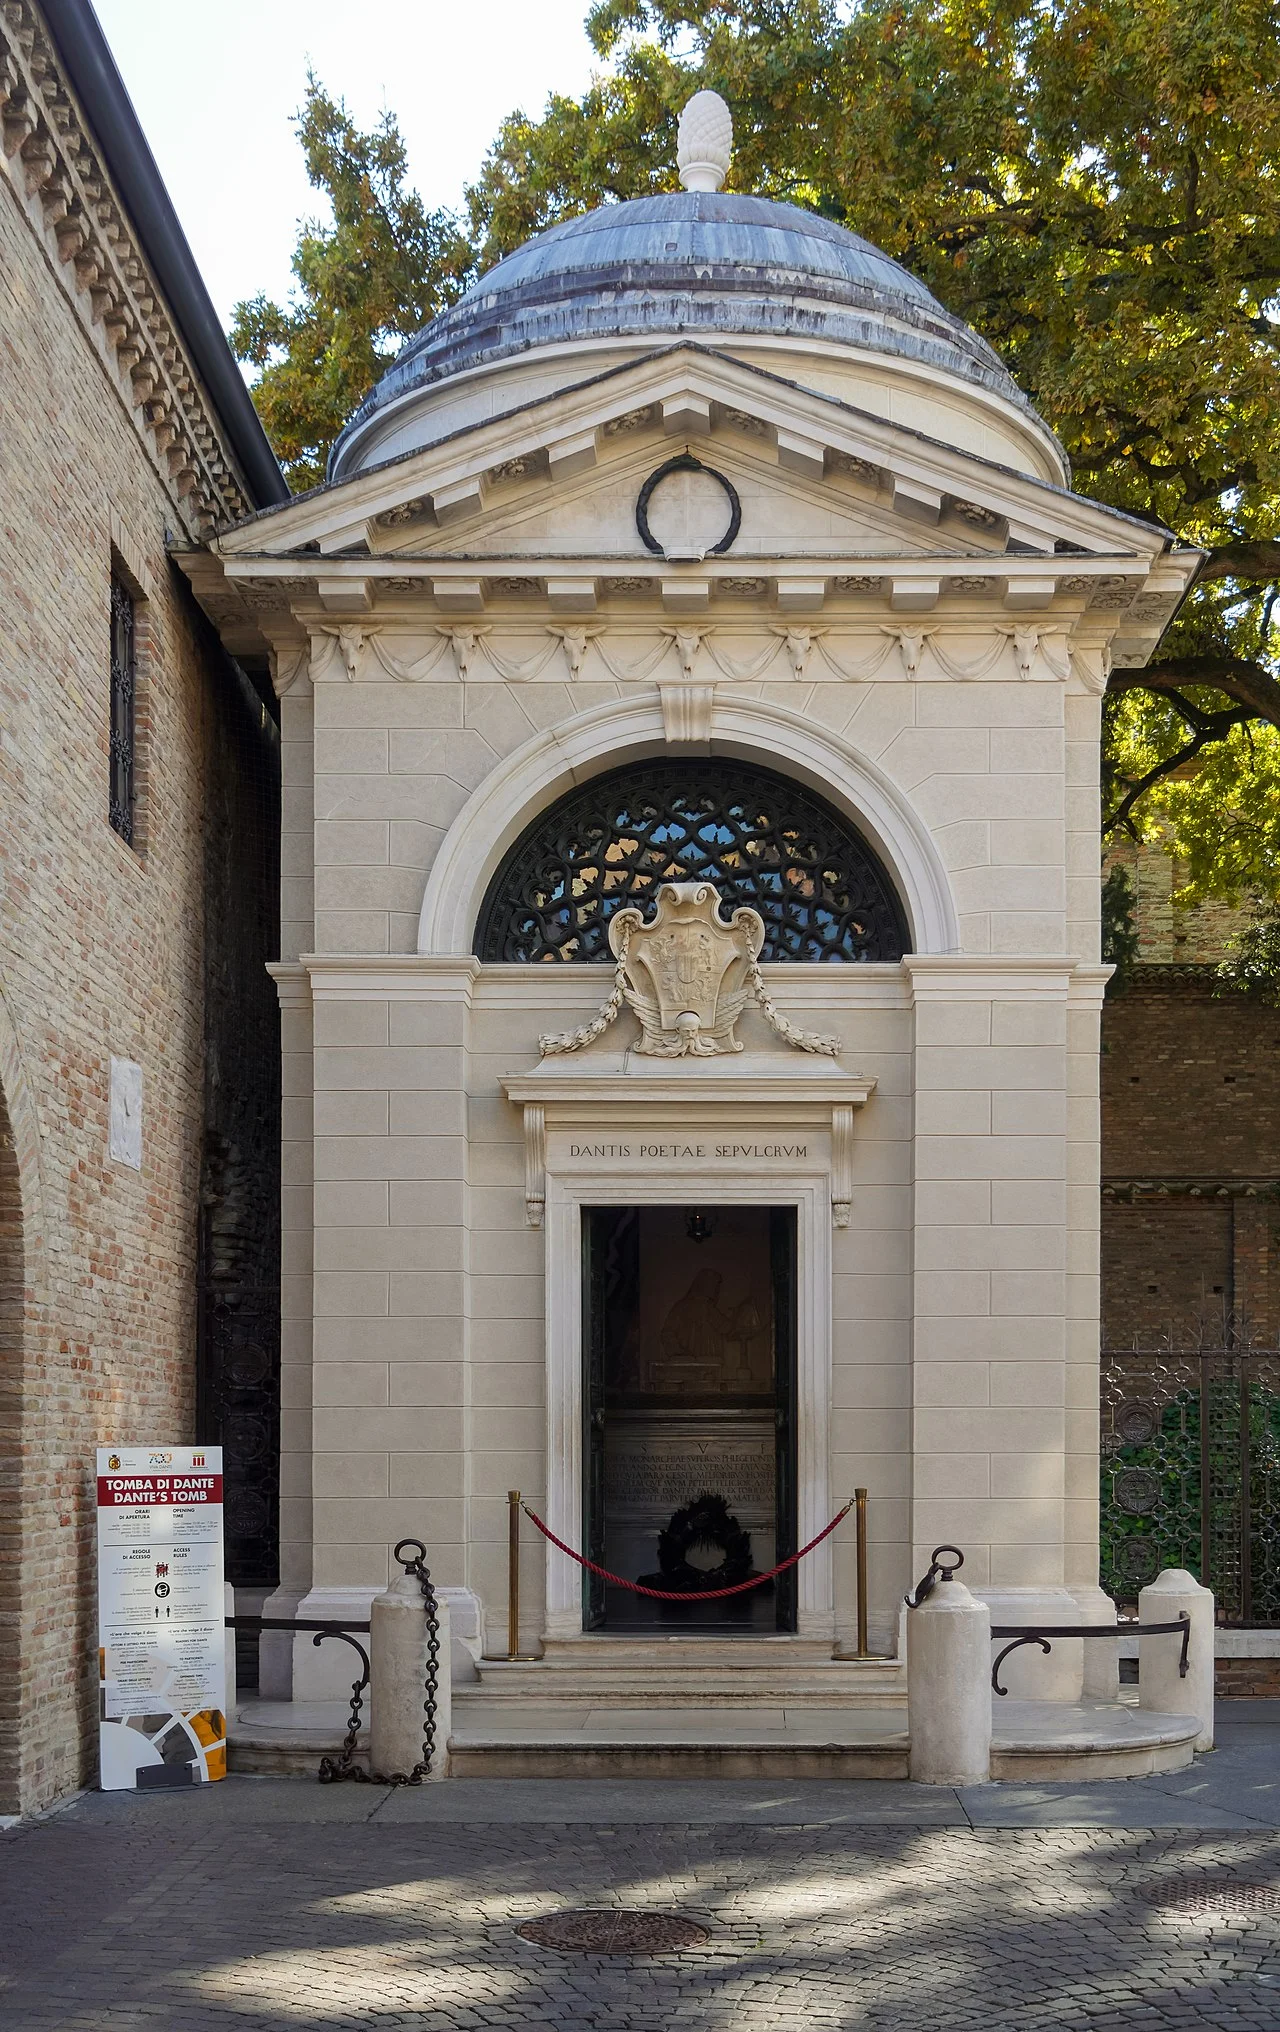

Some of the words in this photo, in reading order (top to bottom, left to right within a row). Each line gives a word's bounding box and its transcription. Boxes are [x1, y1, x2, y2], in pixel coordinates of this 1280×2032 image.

[570, 1145, 631, 1157] DANTIS
[640, 1145, 706, 1157] POETAE
[715, 1145, 808, 1157] SEPVLCRVM
[698, 1443, 709, 1454] V
[106, 1479, 154, 1491] TOMBA
[157, 1479, 170, 1490] DI
[173, 1478, 214, 1489] DANTE
[114, 1491, 168, 1503] DANTE'S
[171, 1491, 208, 1502] TOMB
